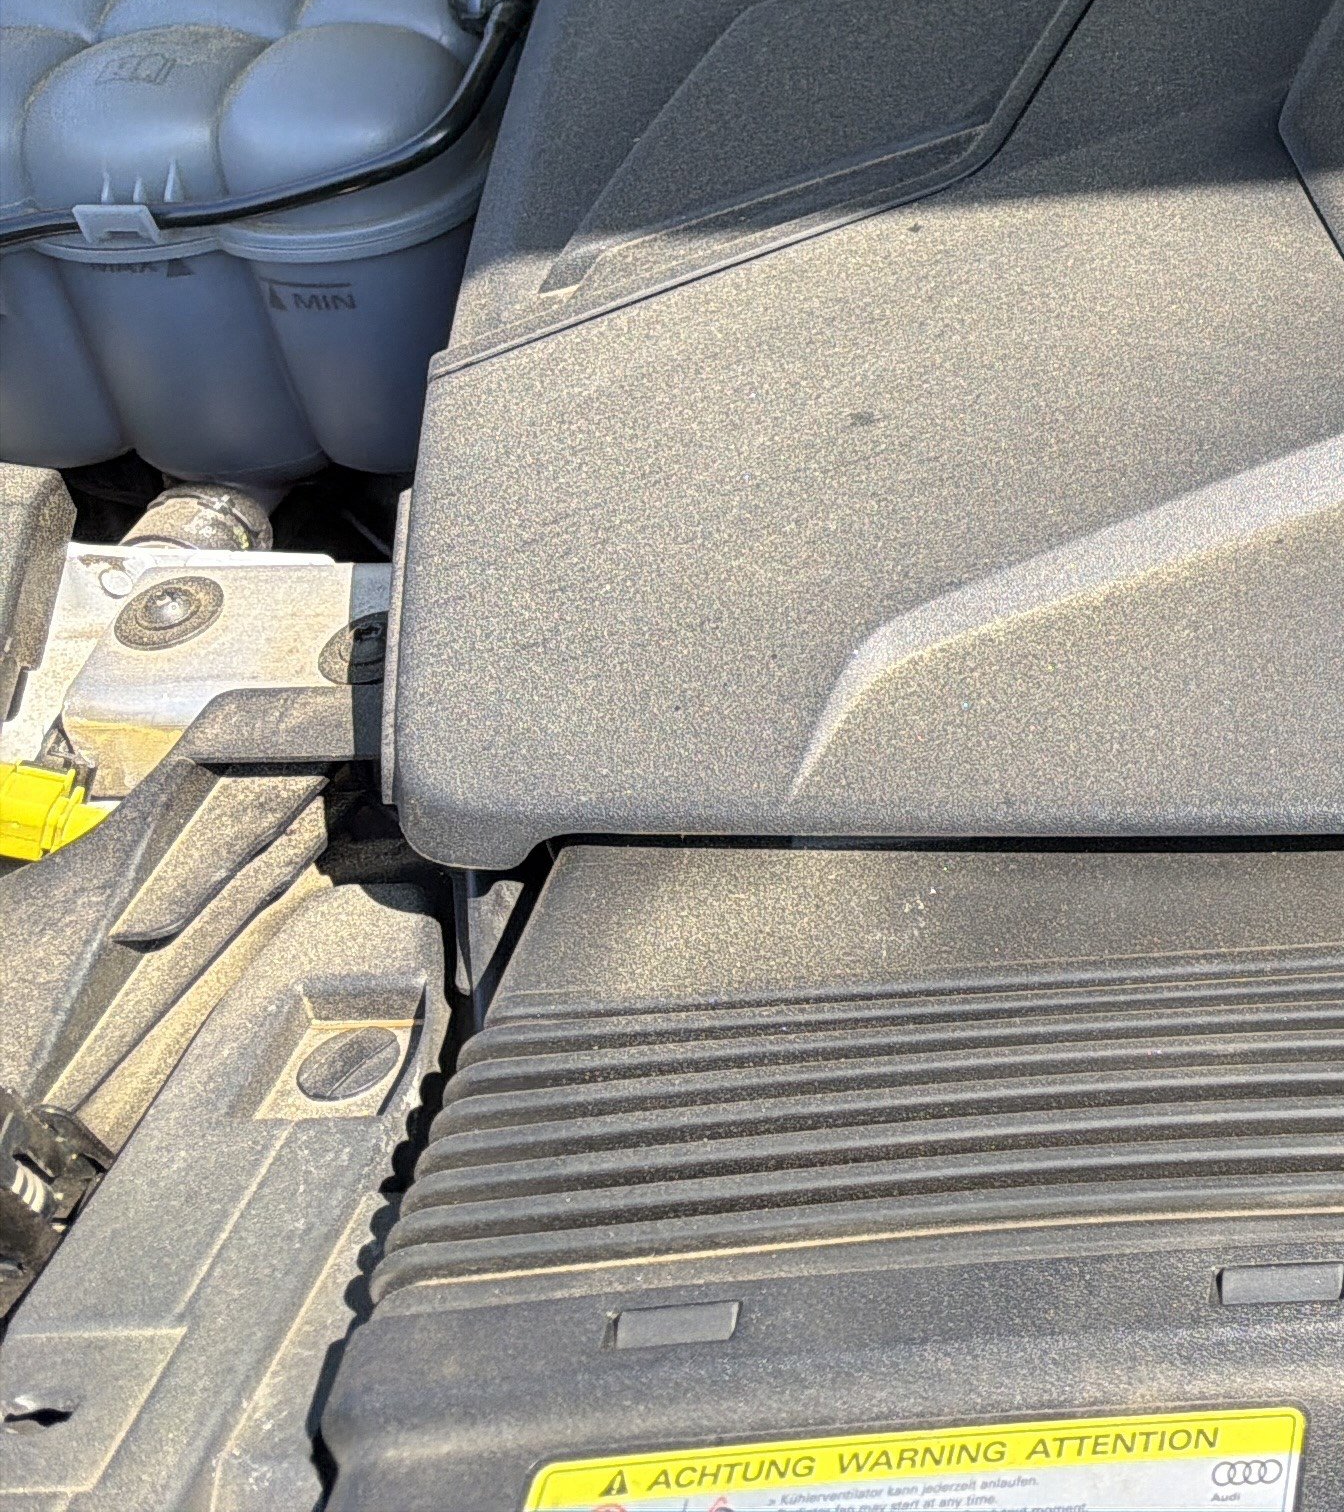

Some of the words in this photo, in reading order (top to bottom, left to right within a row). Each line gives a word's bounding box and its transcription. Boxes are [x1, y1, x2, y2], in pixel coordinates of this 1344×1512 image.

[291, 293, 357, 310] MIN
[648, 1455, 816, 1491] ACHTUNG
[838, 1441, 1008, 1474] WARNING
[1025, 1427, 1220, 1460] ATTENTION
[780, 1488, 884, 1506] Kühlerventilator
[887, 1485, 919, 1497] kann
[921, 1478, 977, 1496] jederzeit
[980, 1475, 1040, 1489] anlaufen.
[1211, 1491, 1241, 1503] Audi
[890, 1500, 920, 1510] start
[923, 1498, 935, 1508] at
[938, 1496, 963, 1509] any
[966, 1494, 997, 1507] time.
